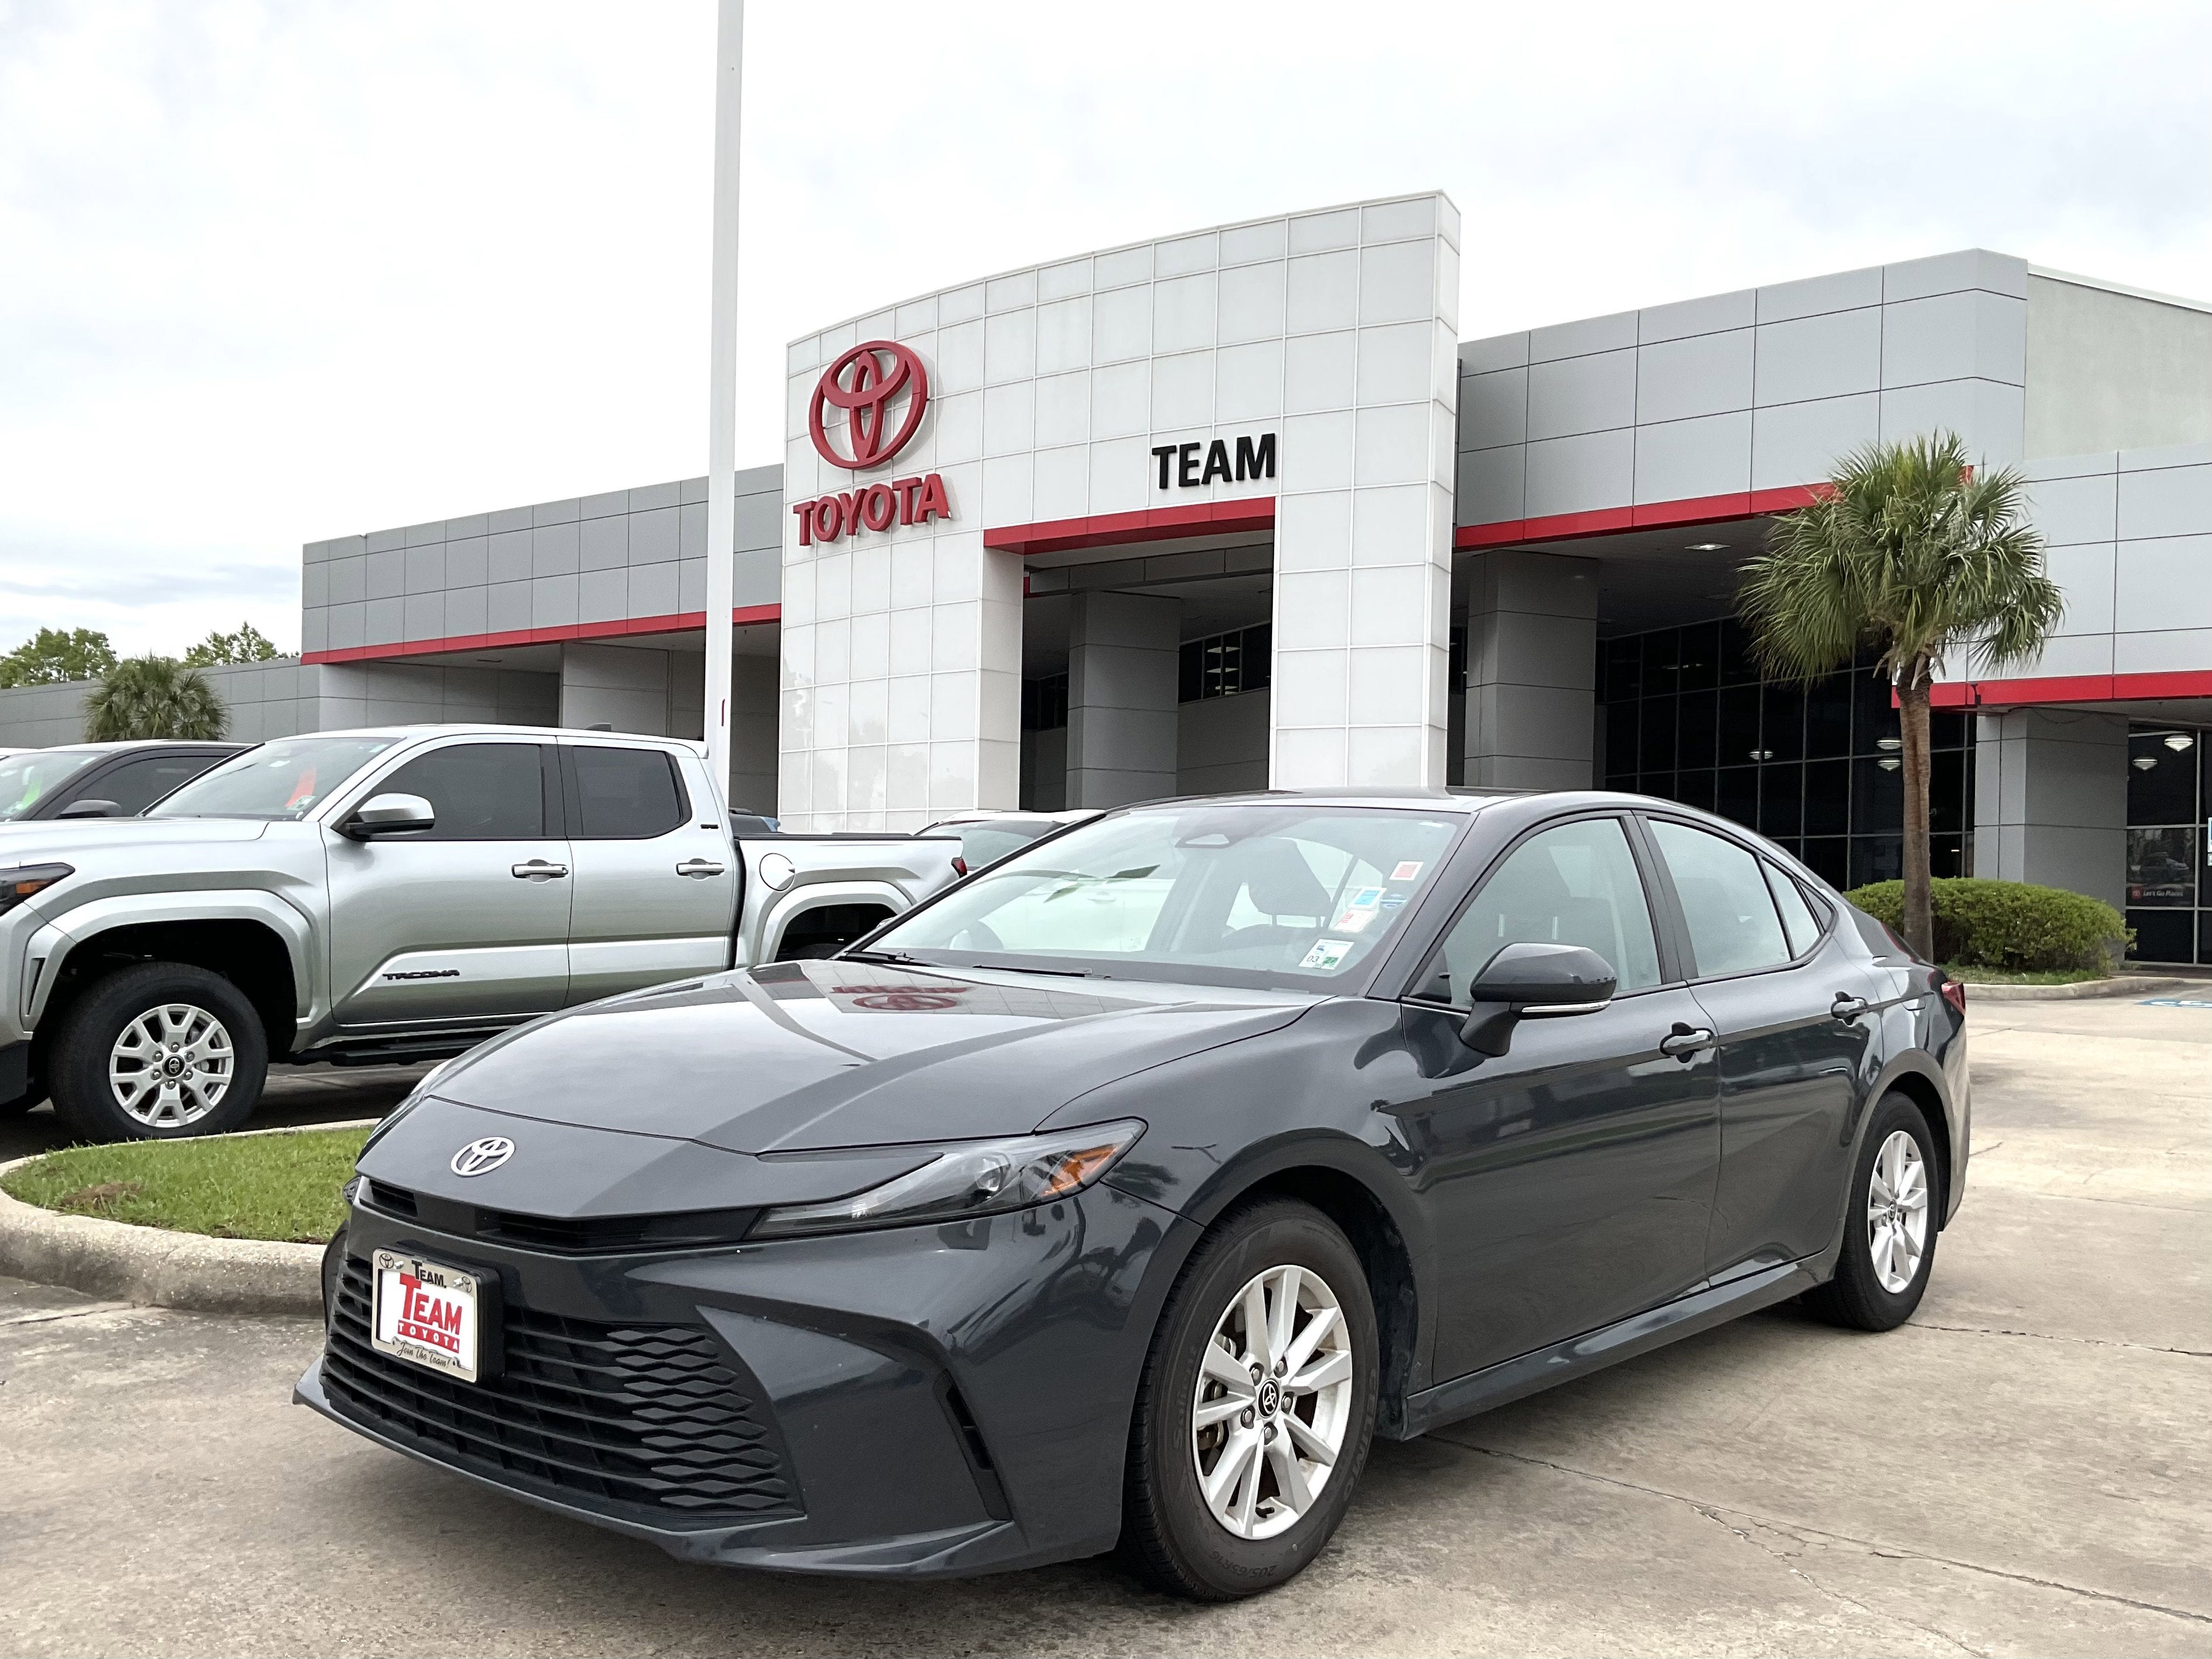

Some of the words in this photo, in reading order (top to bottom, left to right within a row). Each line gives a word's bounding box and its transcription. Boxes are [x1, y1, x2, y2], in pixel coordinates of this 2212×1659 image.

[1152, 433, 1276, 489] TEAM
[792, 473, 949, 546] TOYOTA
[382, 969, 460, 980] TACOMA
[400, 1273, 462, 1335] TEAM
[397, 1342, 414, 1356] Join
[399, 1323, 459, 1349] TOYOTA
